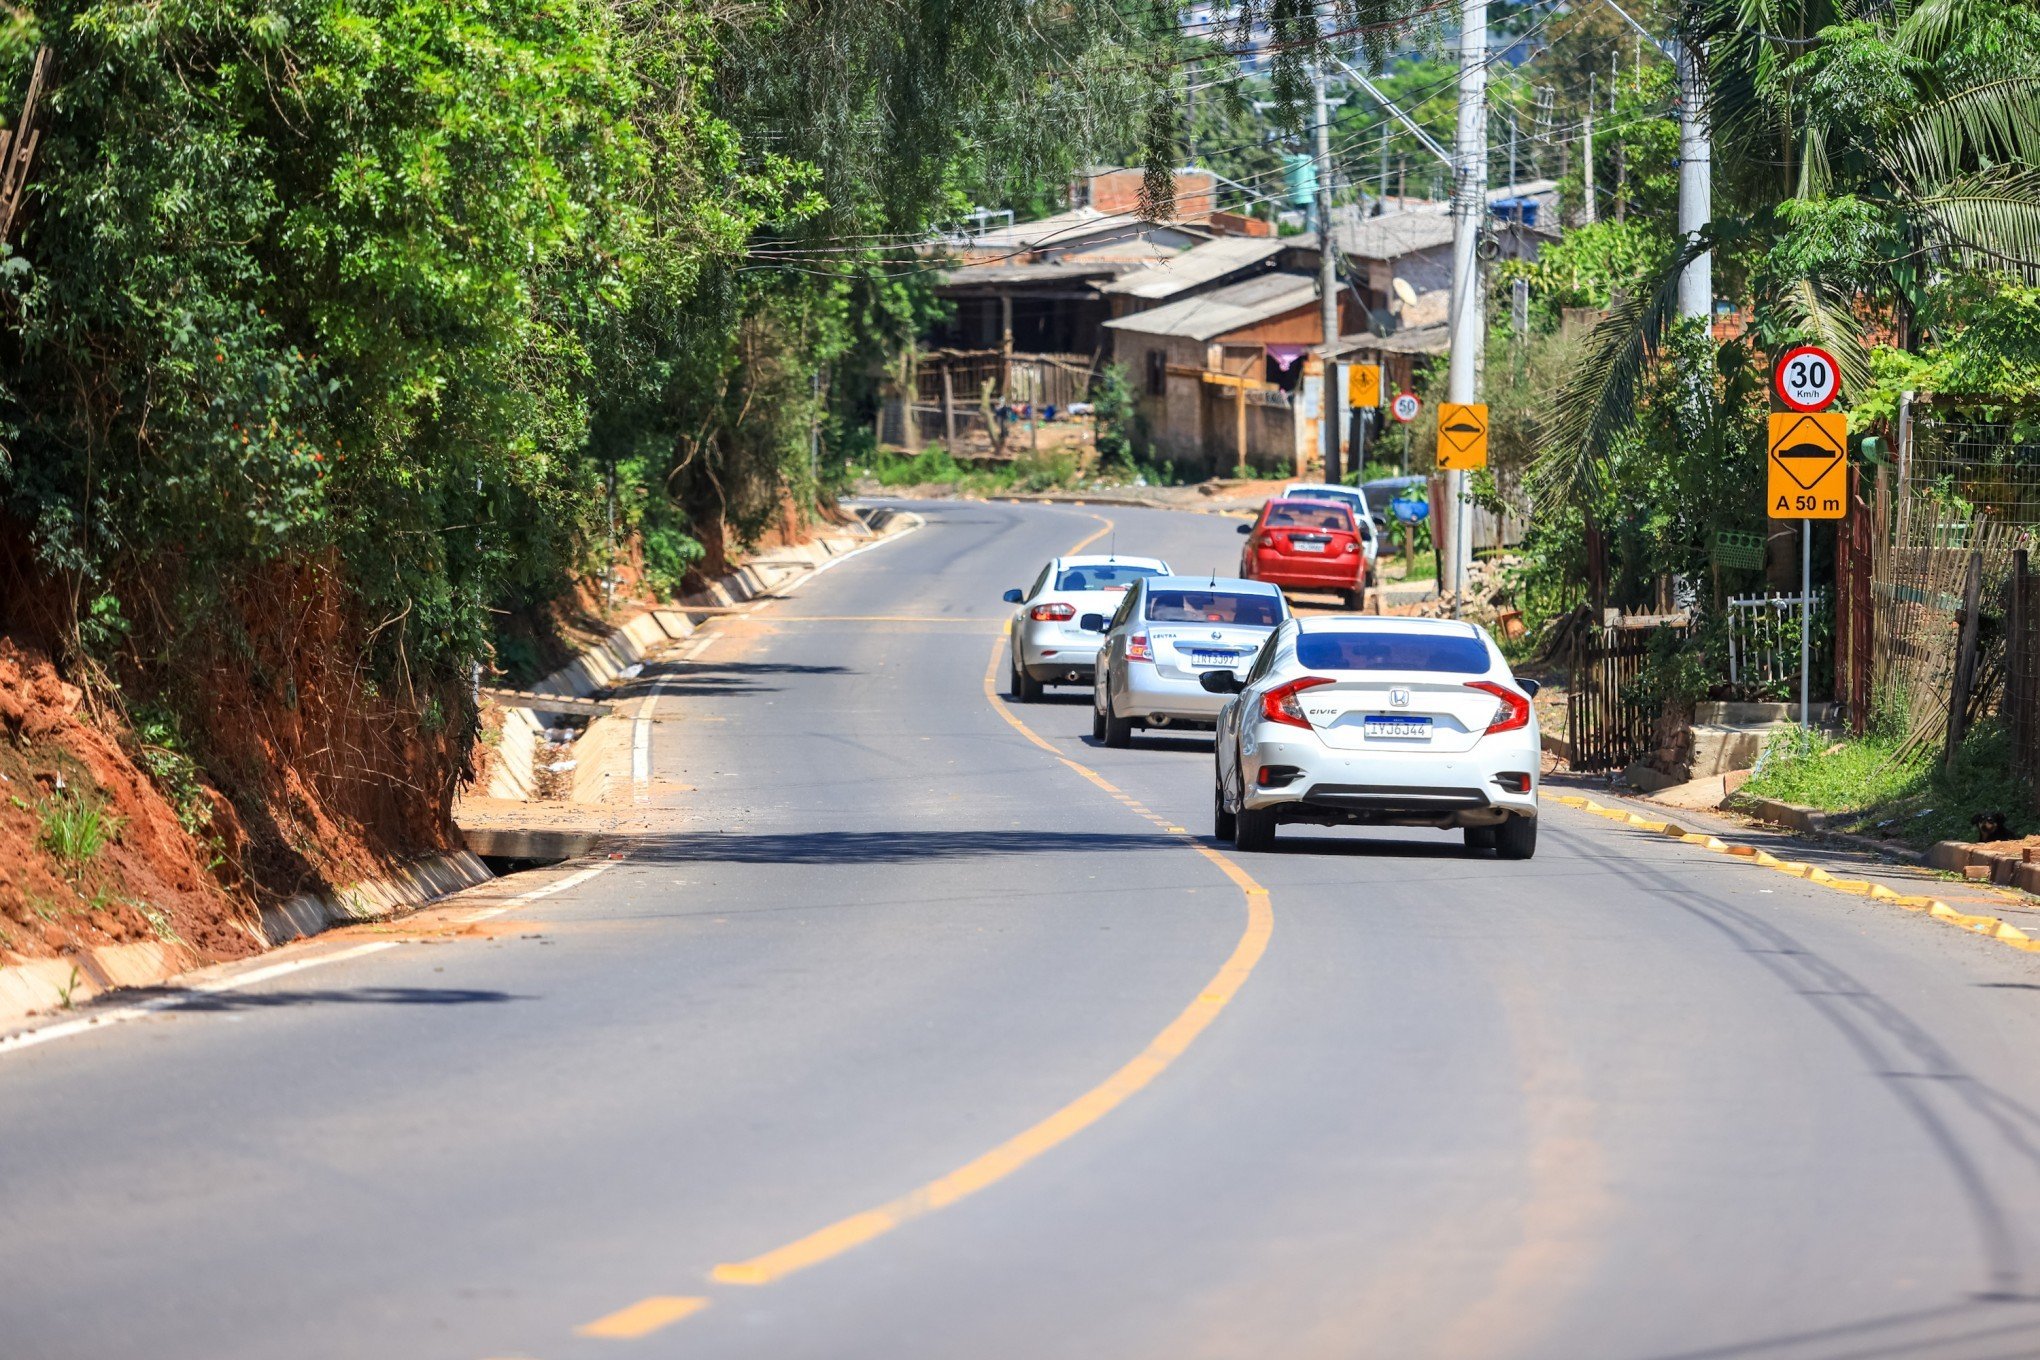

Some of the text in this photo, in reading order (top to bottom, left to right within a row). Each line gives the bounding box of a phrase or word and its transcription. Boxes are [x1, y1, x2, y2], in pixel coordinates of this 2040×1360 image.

[1790, 361, 1826, 389] 30
[1796, 390, 1820, 398] Km/h
[1398, 399, 1416, 413] 50
[1776, 495, 1840, 511] A 50 m
[1370, 723, 1425, 736] IYJ6J44
